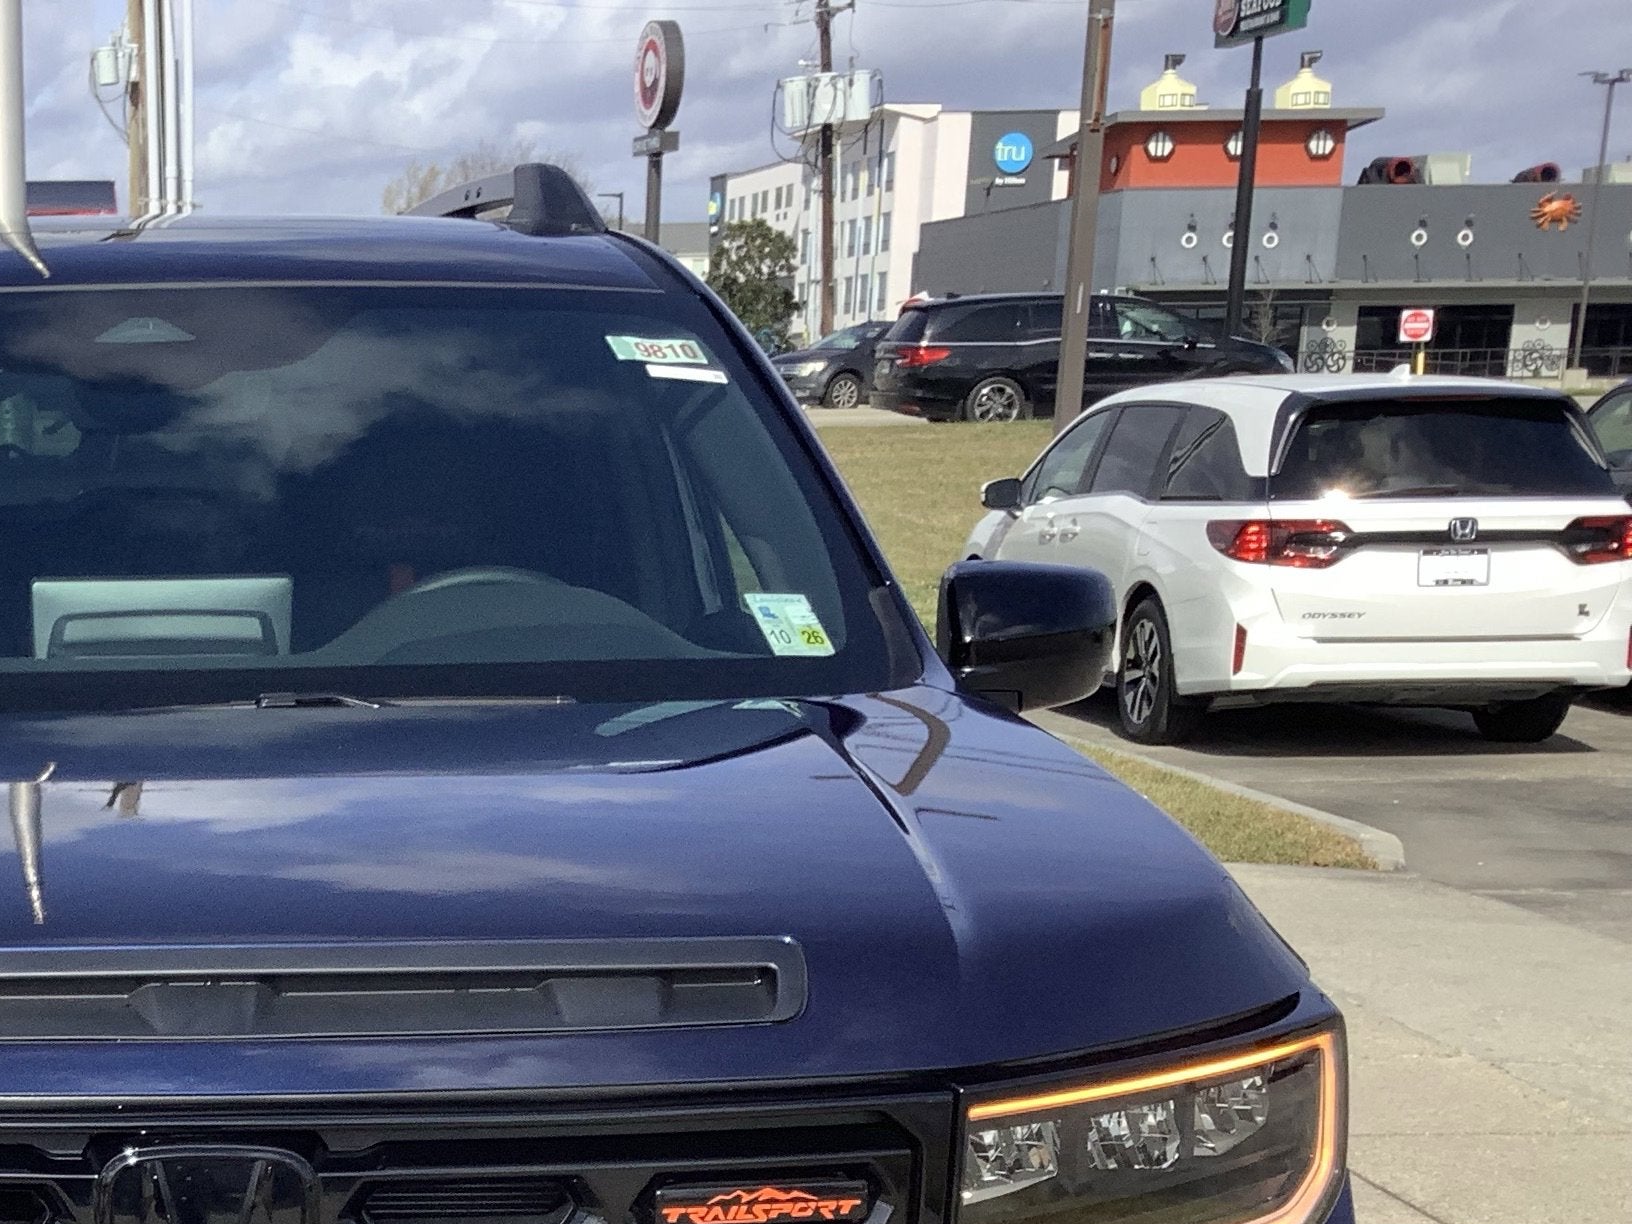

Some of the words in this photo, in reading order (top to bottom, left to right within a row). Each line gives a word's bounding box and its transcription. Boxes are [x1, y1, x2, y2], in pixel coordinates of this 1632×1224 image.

[995, 142, 1026, 161] tru
[634, 342, 699, 359] 9810
[1302, 612, 1367, 620] ODYSSEY
[770, 629, 792, 645] 10
[801, 629, 825, 645] 26
